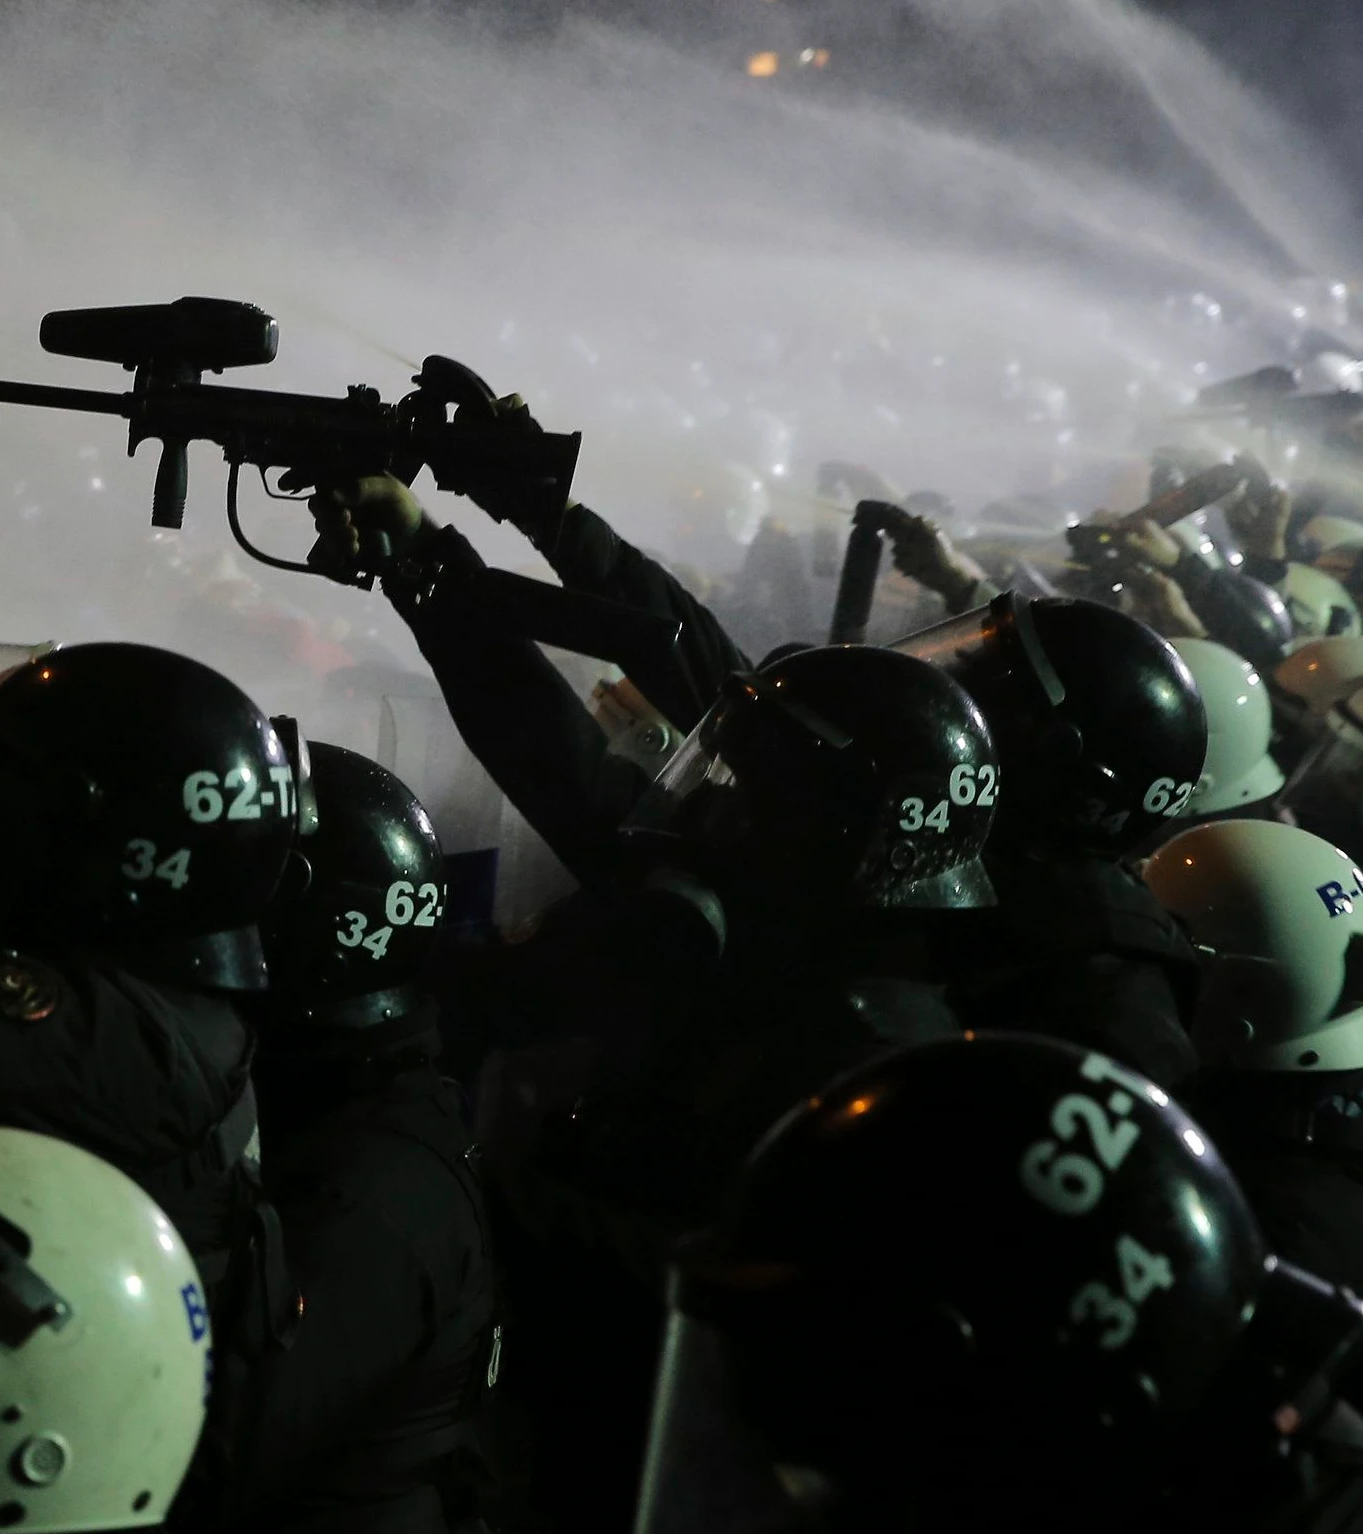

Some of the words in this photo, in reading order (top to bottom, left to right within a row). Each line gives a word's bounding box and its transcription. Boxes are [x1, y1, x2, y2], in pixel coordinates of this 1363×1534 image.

[183, 763, 297, 823] 62-T
[899, 797, 950, 834] 34
[1076, 797, 1131, 837] 34
[121, 838, 192, 889] 34
[336, 910, 393, 960] 34
[1068, 1232, 1176, 1351] 34
